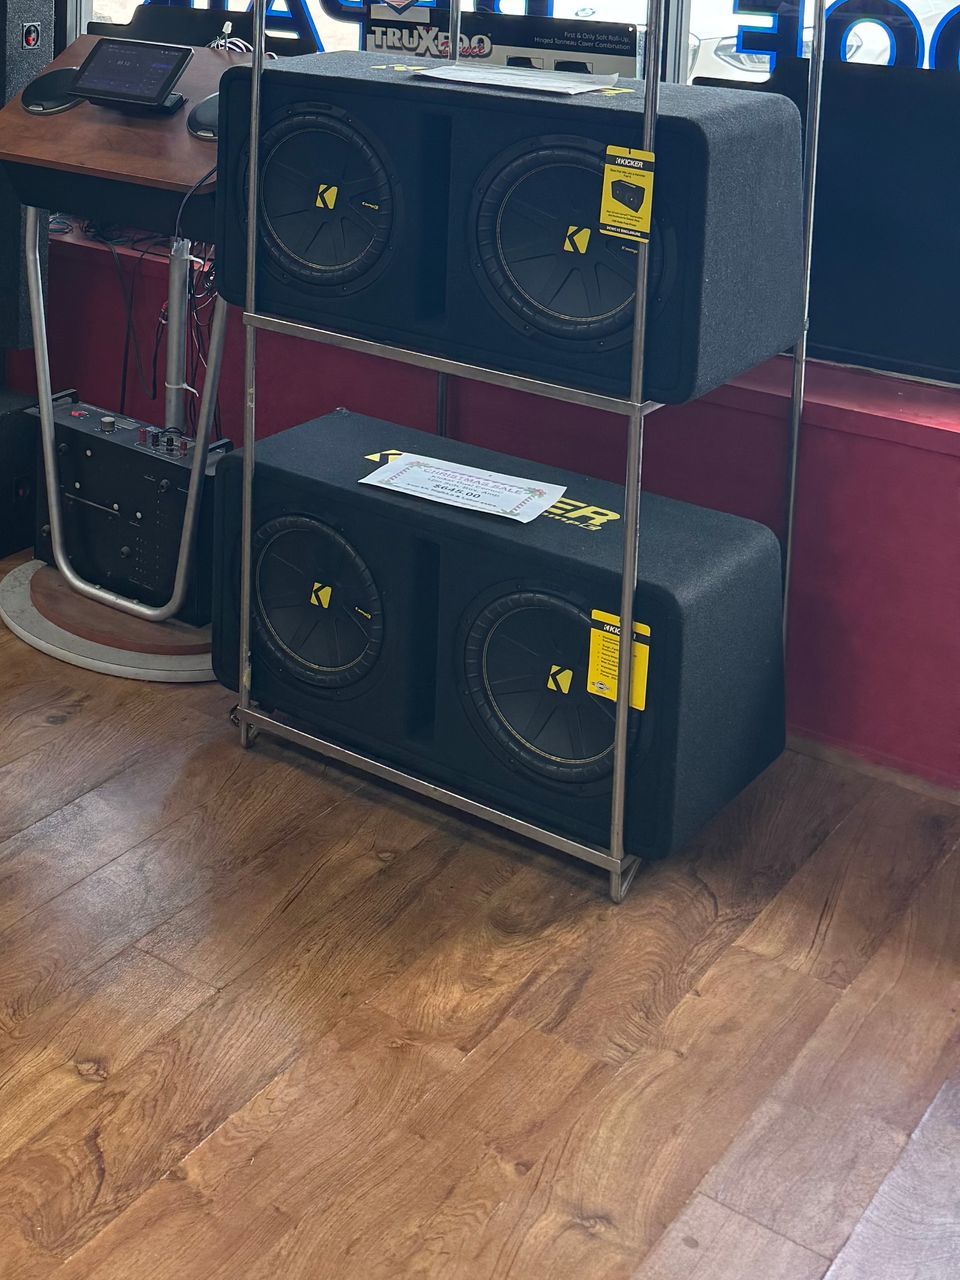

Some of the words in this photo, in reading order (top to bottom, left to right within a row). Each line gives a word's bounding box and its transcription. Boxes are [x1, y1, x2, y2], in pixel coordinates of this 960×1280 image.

[534, 36, 554, 44] Hinged
[554, 37, 577, 46] Tonneau
[578, 39, 594, 47] Cover
[594, 41, 631, 50] Combination
[564, 31, 576, 39] First
[582, 32, 595, 41] Only
[596, 33, 608, 41] Soft
[619, 158, 644, 168] KICKER
[423, 468, 489, 488] CHRISTMAS
[492, 484, 522, 495] SALE
[433, 483, 481, 498] $645.00
